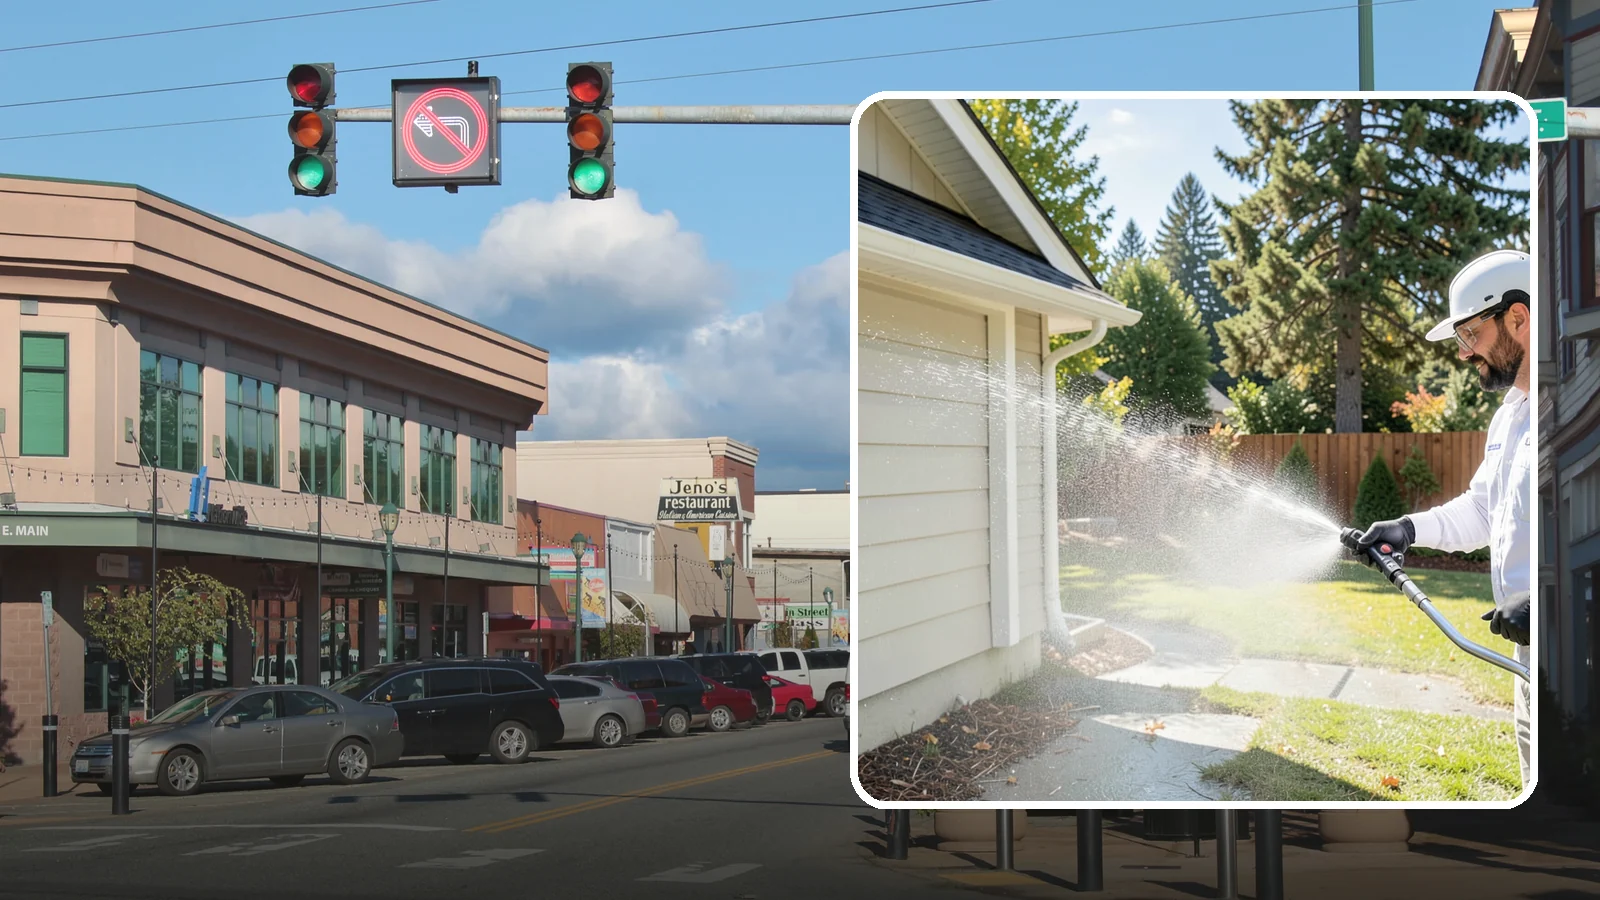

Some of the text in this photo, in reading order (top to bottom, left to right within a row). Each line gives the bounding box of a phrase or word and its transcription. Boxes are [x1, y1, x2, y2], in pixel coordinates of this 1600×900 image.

[669, 480, 728, 494] Jeno's
[665, 496, 731, 509] restaurant
[658, 510, 681, 519] Italian
[685, 510, 714, 519] American
[714, 510, 737, 519] Cuisine
[2, 525, 49, 536] E. MAIN
[797, 607, 829, 617] Street
